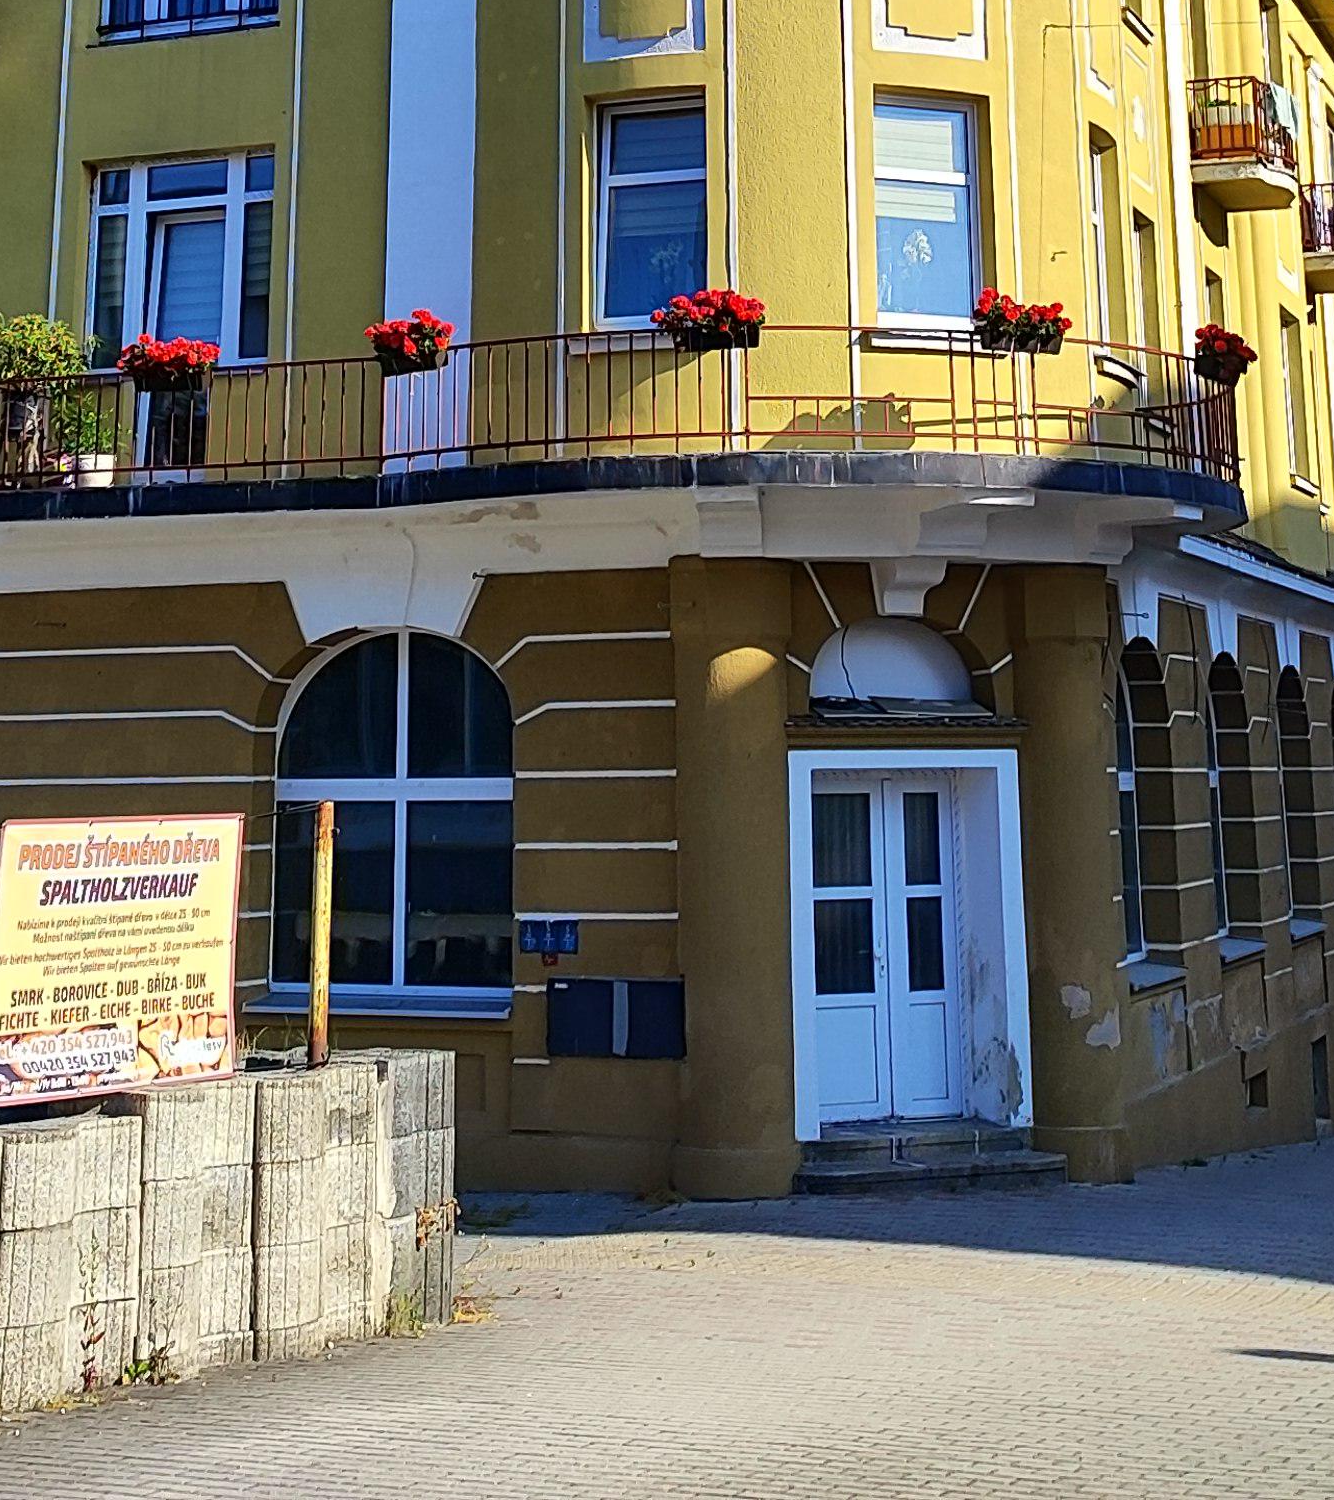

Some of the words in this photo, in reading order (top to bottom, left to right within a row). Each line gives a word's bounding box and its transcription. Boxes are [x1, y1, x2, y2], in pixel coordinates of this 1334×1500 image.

[18, 843, 82, 871] PRODEJ
[83, 833, 170, 868] ŠTÍPANÉHO
[172, 831, 220, 864] DŘEVA
[39, 873, 199, 906] SPALTHOLZVERKAUF
[10, 988, 45, 1008] SMRK
[53, 981, 108, 1003] BOROVICE
[117, 979, 139, 997] DUB
[147, 971, 178, 993] BŘÍZA
[186, 972, 207, 990] BUK
[50, 1005, 90, 1026] KIEFER
[100, 1001, 131, 1019] EICHE
[141, 996, 172, 1015] BIRKE
[182, 992, 215, 1011] BUCHE
[31, 1040, 56, 1055] 420
[60, 1037, 83, 1053] 354
[22, 1058, 65, 1074] 00420
[65, 1054, 89, 1069] 354
